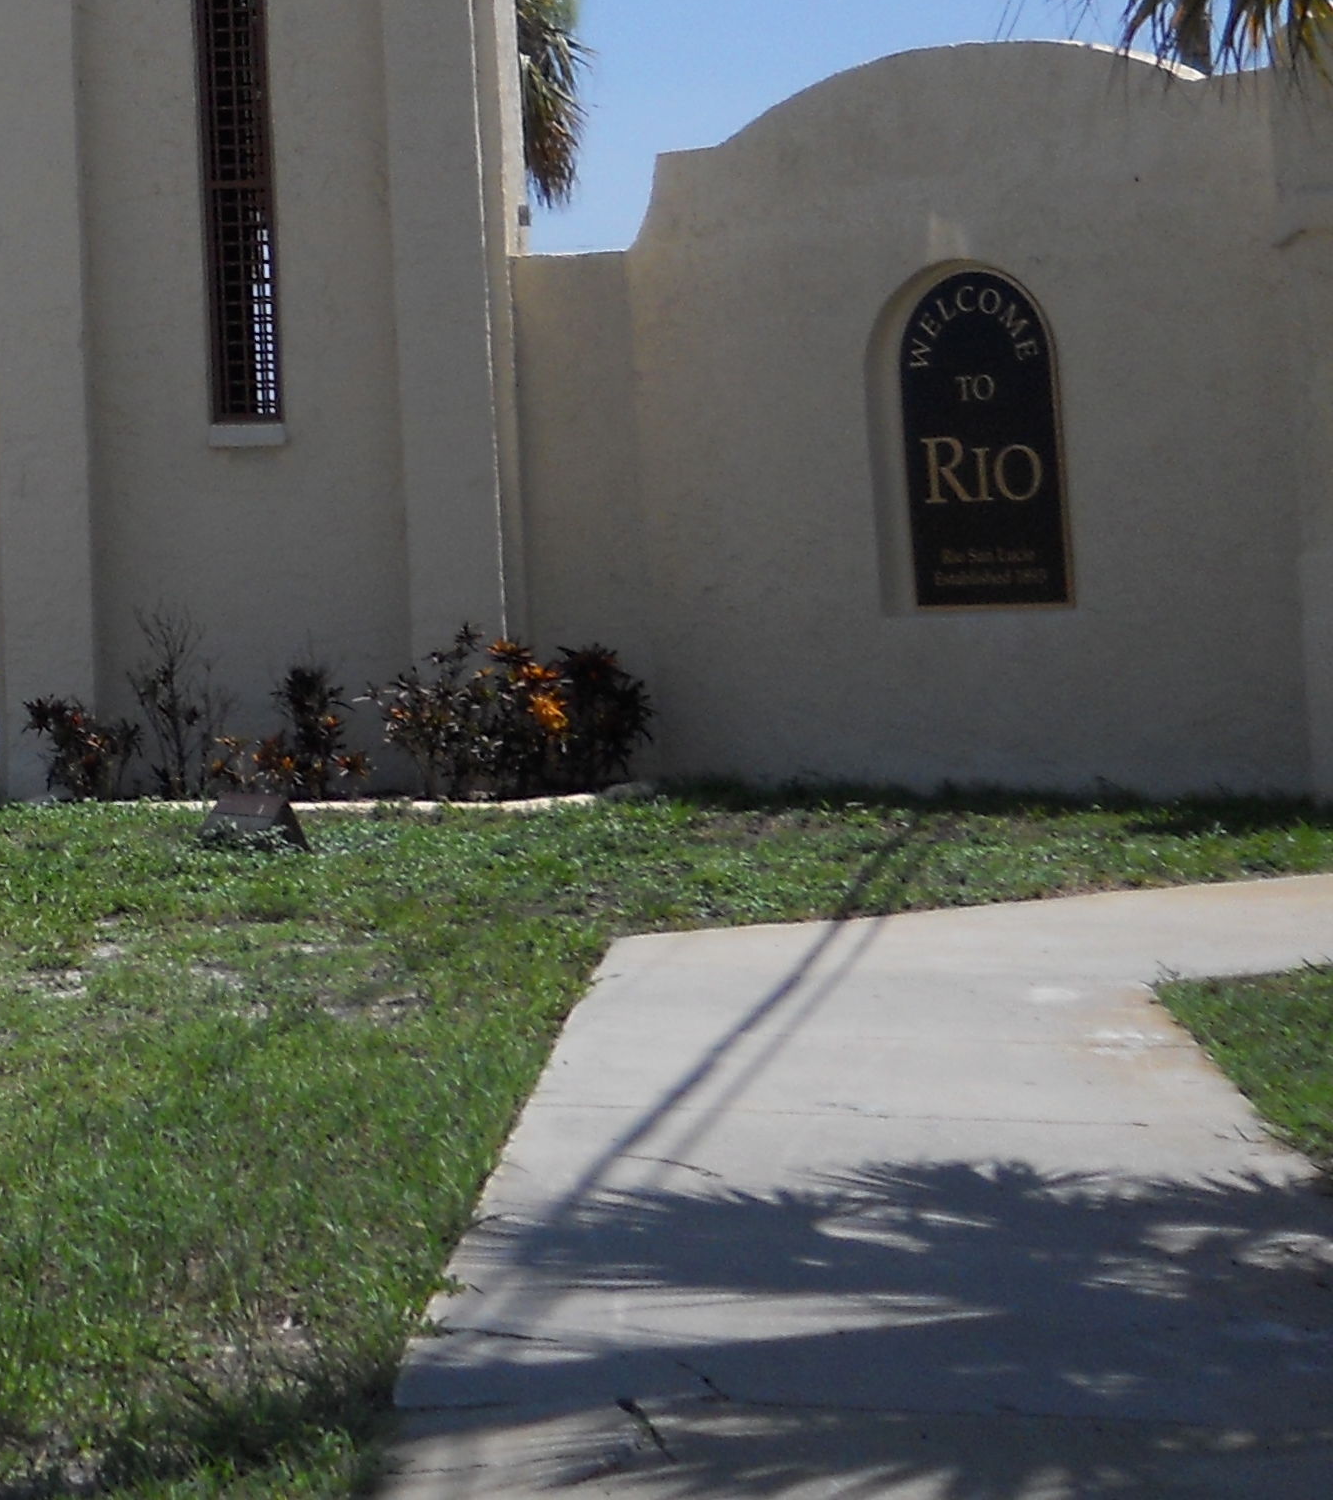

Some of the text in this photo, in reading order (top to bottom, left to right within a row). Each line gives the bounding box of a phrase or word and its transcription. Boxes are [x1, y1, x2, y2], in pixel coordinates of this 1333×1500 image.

[909, 285, 1039, 368] WELCOME
[954, 373, 995, 402] TO
[919, 436, 1043, 504] RIO
